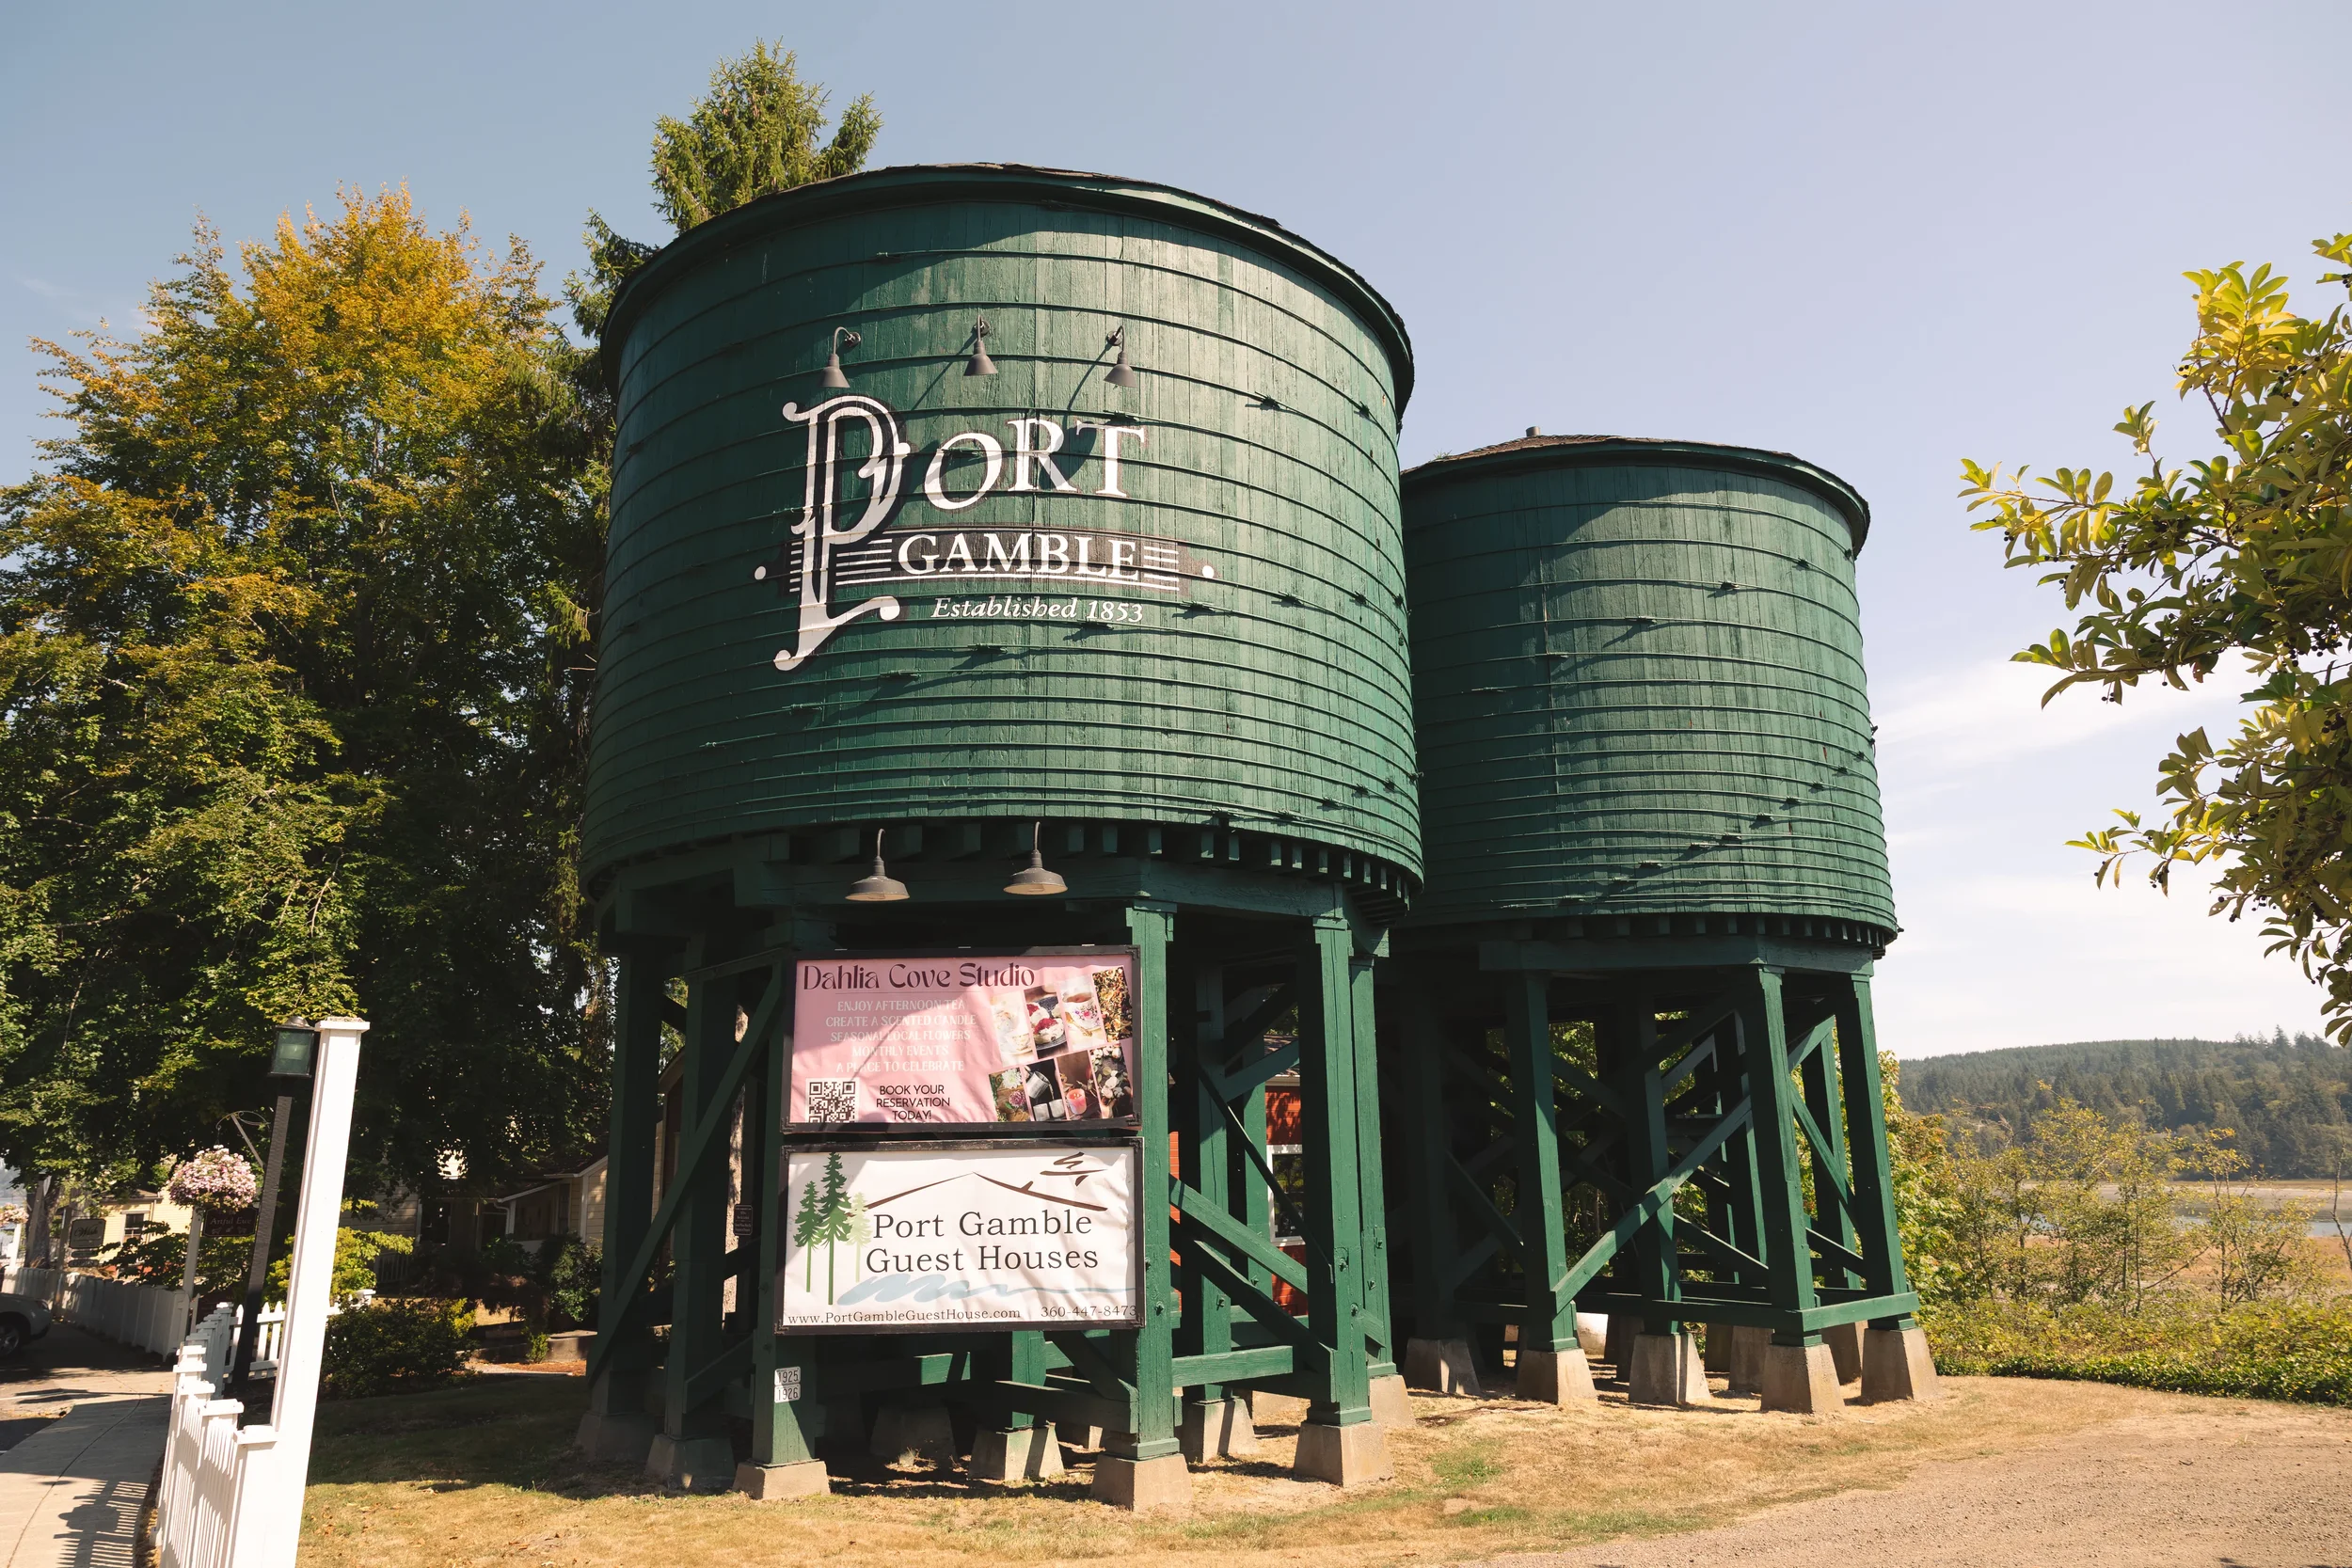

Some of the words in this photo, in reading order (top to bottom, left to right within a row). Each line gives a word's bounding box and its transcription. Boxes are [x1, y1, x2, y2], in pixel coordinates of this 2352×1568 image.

[772, 395, 1146, 672] PORT
[898, 532, 1137, 581] GAMBLE
[930, 595, 1078, 621] Established
[1088, 599, 1143, 624] 1853
[803, 965, 881, 990] Dahlia
[889, 963, 951, 989] Cove
[959, 962, 1035, 987] Studio
[837, 1000, 873, 1012] ENJOY
[875, 999, 942, 1011] AFTERNOON
[945, 999, 965, 1010] TEA
[826, 1016, 868, 1027] CREATE
[871, 1016, 879, 1026] A
[881, 1015, 931, 1026] SCENTED
[934, 1014, 977, 1025] CANDLE
[831, 1031, 884, 1042] SEASONAL
[887, 1030, 921, 1041] LOCAL
[923, 1029, 971, 1040] FLOWERS
[852, 1045, 904, 1057] MONTHLY
[907, 1044, 949, 1055] EVENTS
[836, 1062, 844, 1072] A
[847, 1061, 882, 1072] PLACE
[883, 1061, 899, 1072] TO
[902, 1060, 964, 1071] CELEBRATE
[880, 1085, 911, 1095] BOOK
[914, 1085, 945, 1095] YOUR
[876, 1097, 950, 1108] RESERVATION
[892, 1110, 931, 1120] TODAY!
[872, 1213, 945, 1239] Port
[959, 1210, 1092, 1237] Gamble
[866, 1247, 964, 1274] Guest
[977, 1244, 1099, 1270] Houses
[787, 1307, 1021, 1324] www.PortGambleGuestHouse.com
[1041, 1305, 1136, 1317] 360-447-8473
[778, 1370, 799, 1383] 1925
[778, 1386, 799, 1401] 1926
